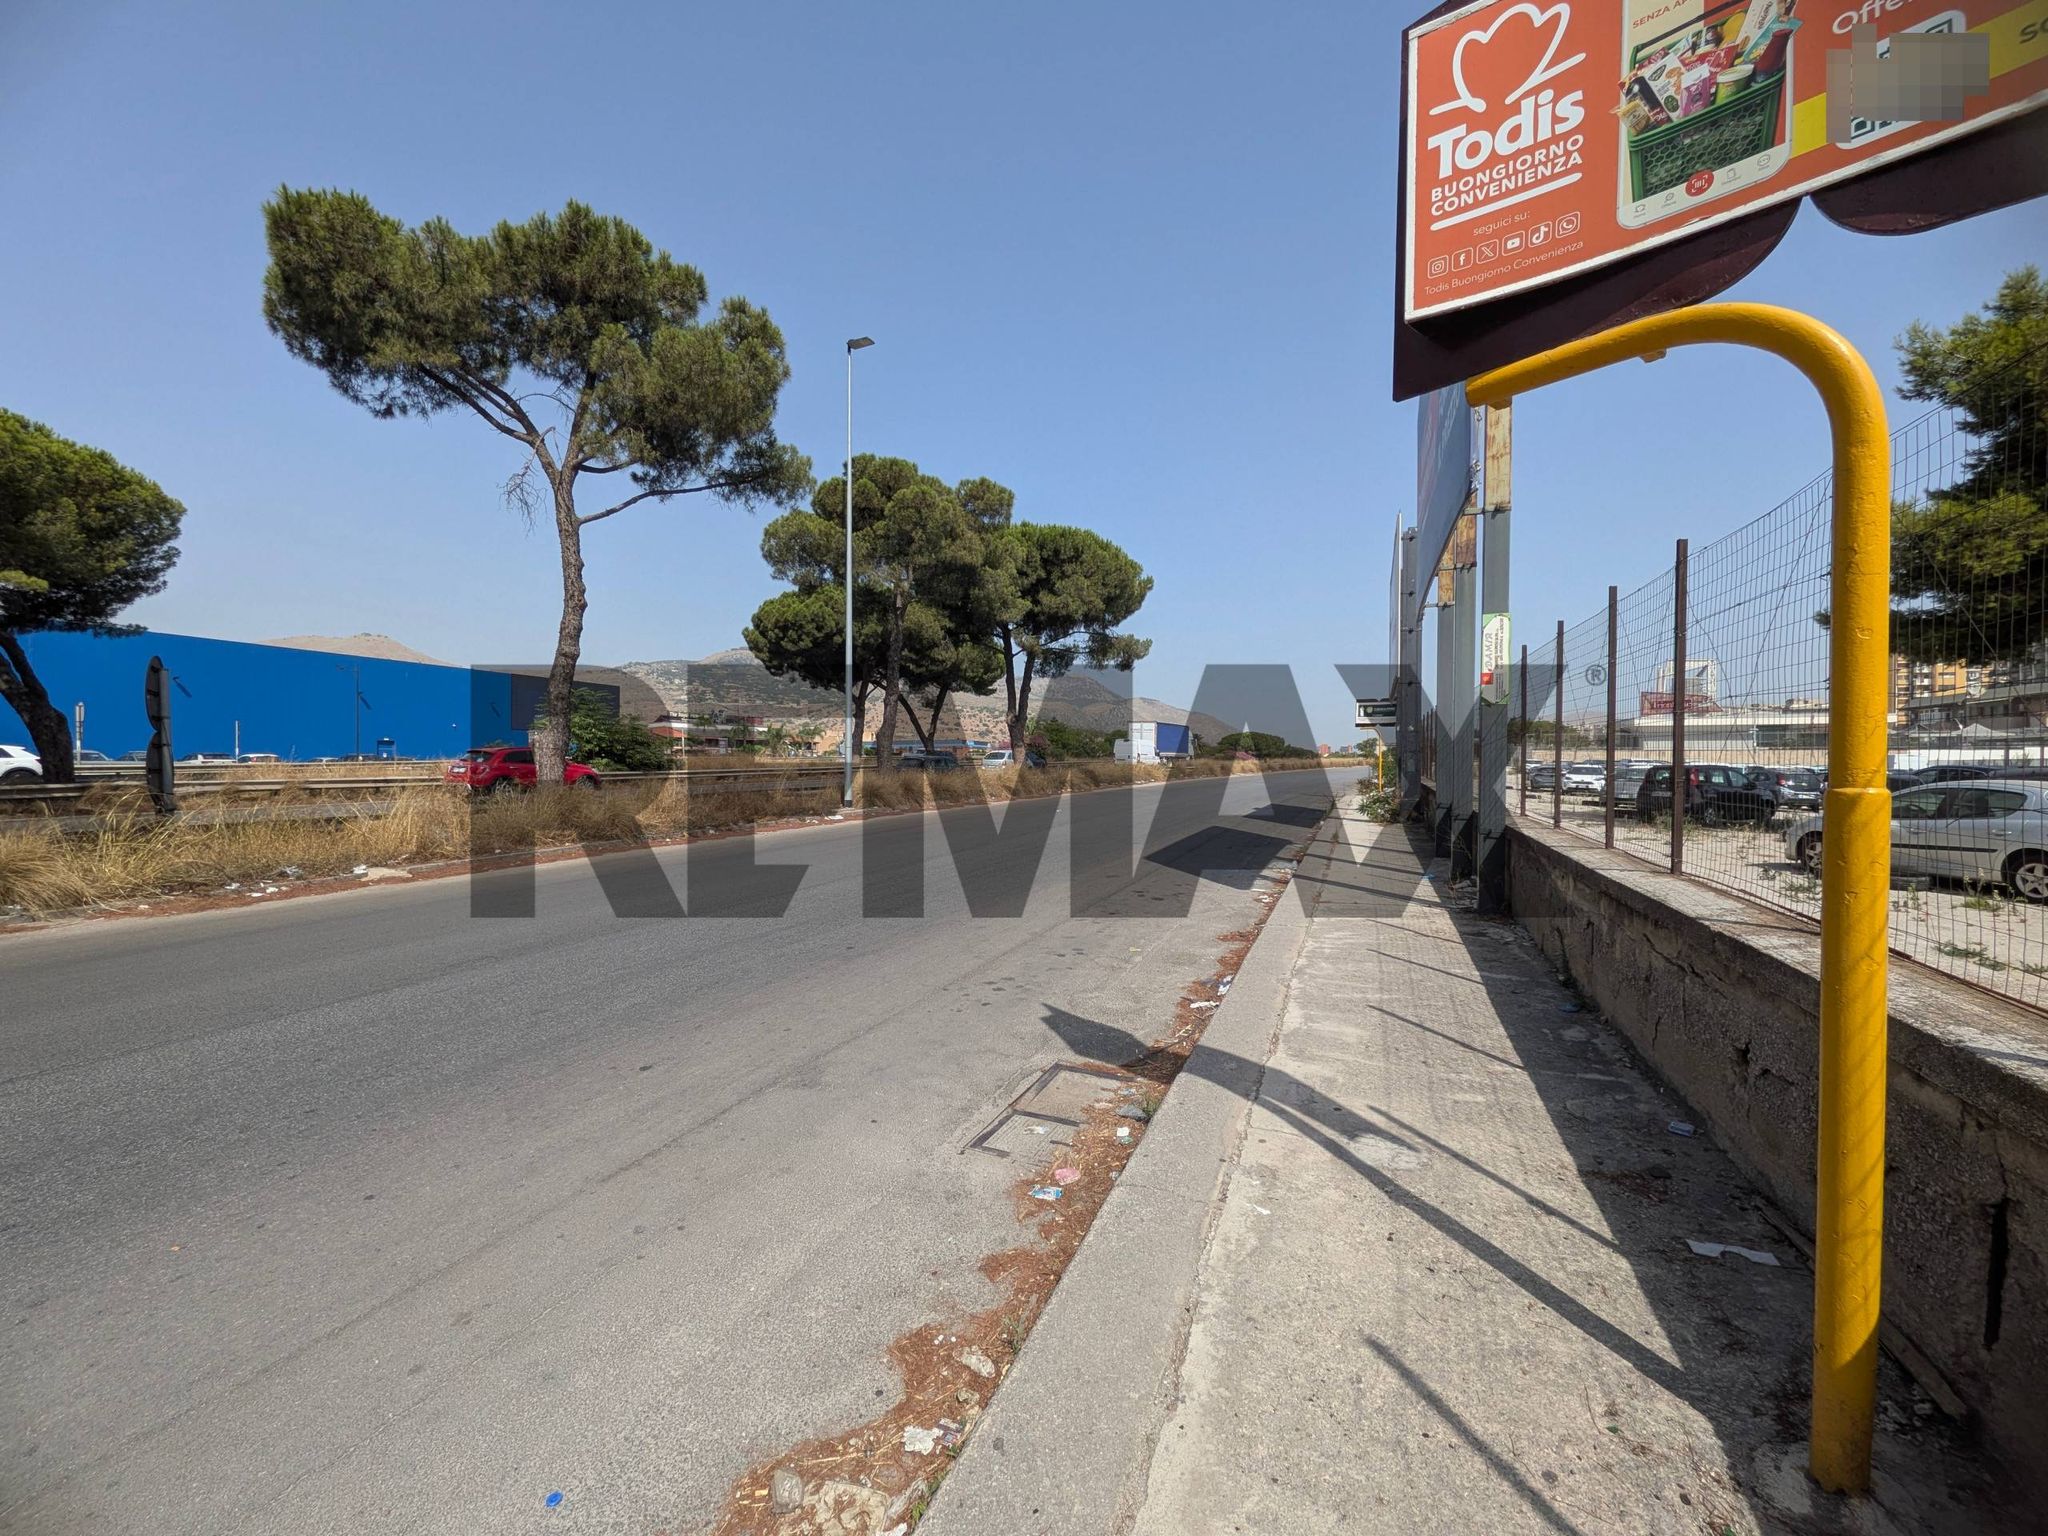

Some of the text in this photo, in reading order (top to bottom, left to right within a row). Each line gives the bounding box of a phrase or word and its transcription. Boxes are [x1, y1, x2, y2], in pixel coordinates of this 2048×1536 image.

[1632, 6, 1671, 29] SENZA
[1427, 89, 1585, 179] Todis
[1431, 134, 1584, 202] BUONGIORNO
[1431, 151, 1583, 216] CONVENIENZA
[1473, 211, 1531, 236] seguici su:
[1424, 241, 1584, 296] Todis Buongiorno Convenienza
